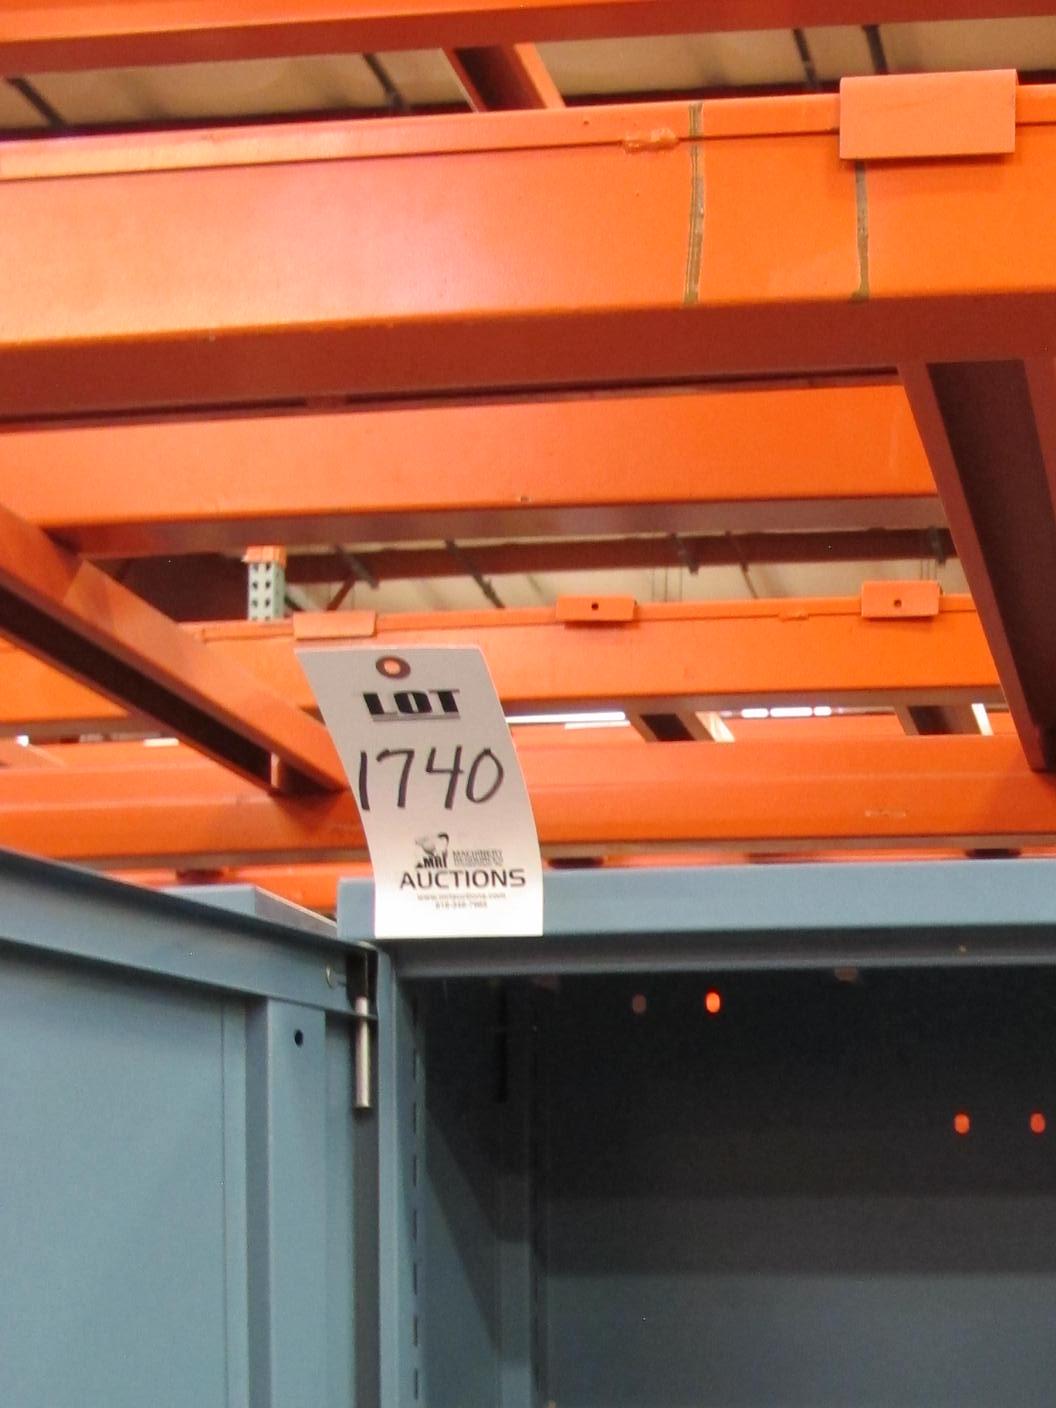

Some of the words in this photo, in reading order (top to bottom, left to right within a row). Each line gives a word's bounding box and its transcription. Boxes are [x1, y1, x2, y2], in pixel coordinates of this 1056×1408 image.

[363, 689, 460, 715] LOT
[358, 744, 505, 811] 1740
[399, 869, 526, 891] AUCTIONS
